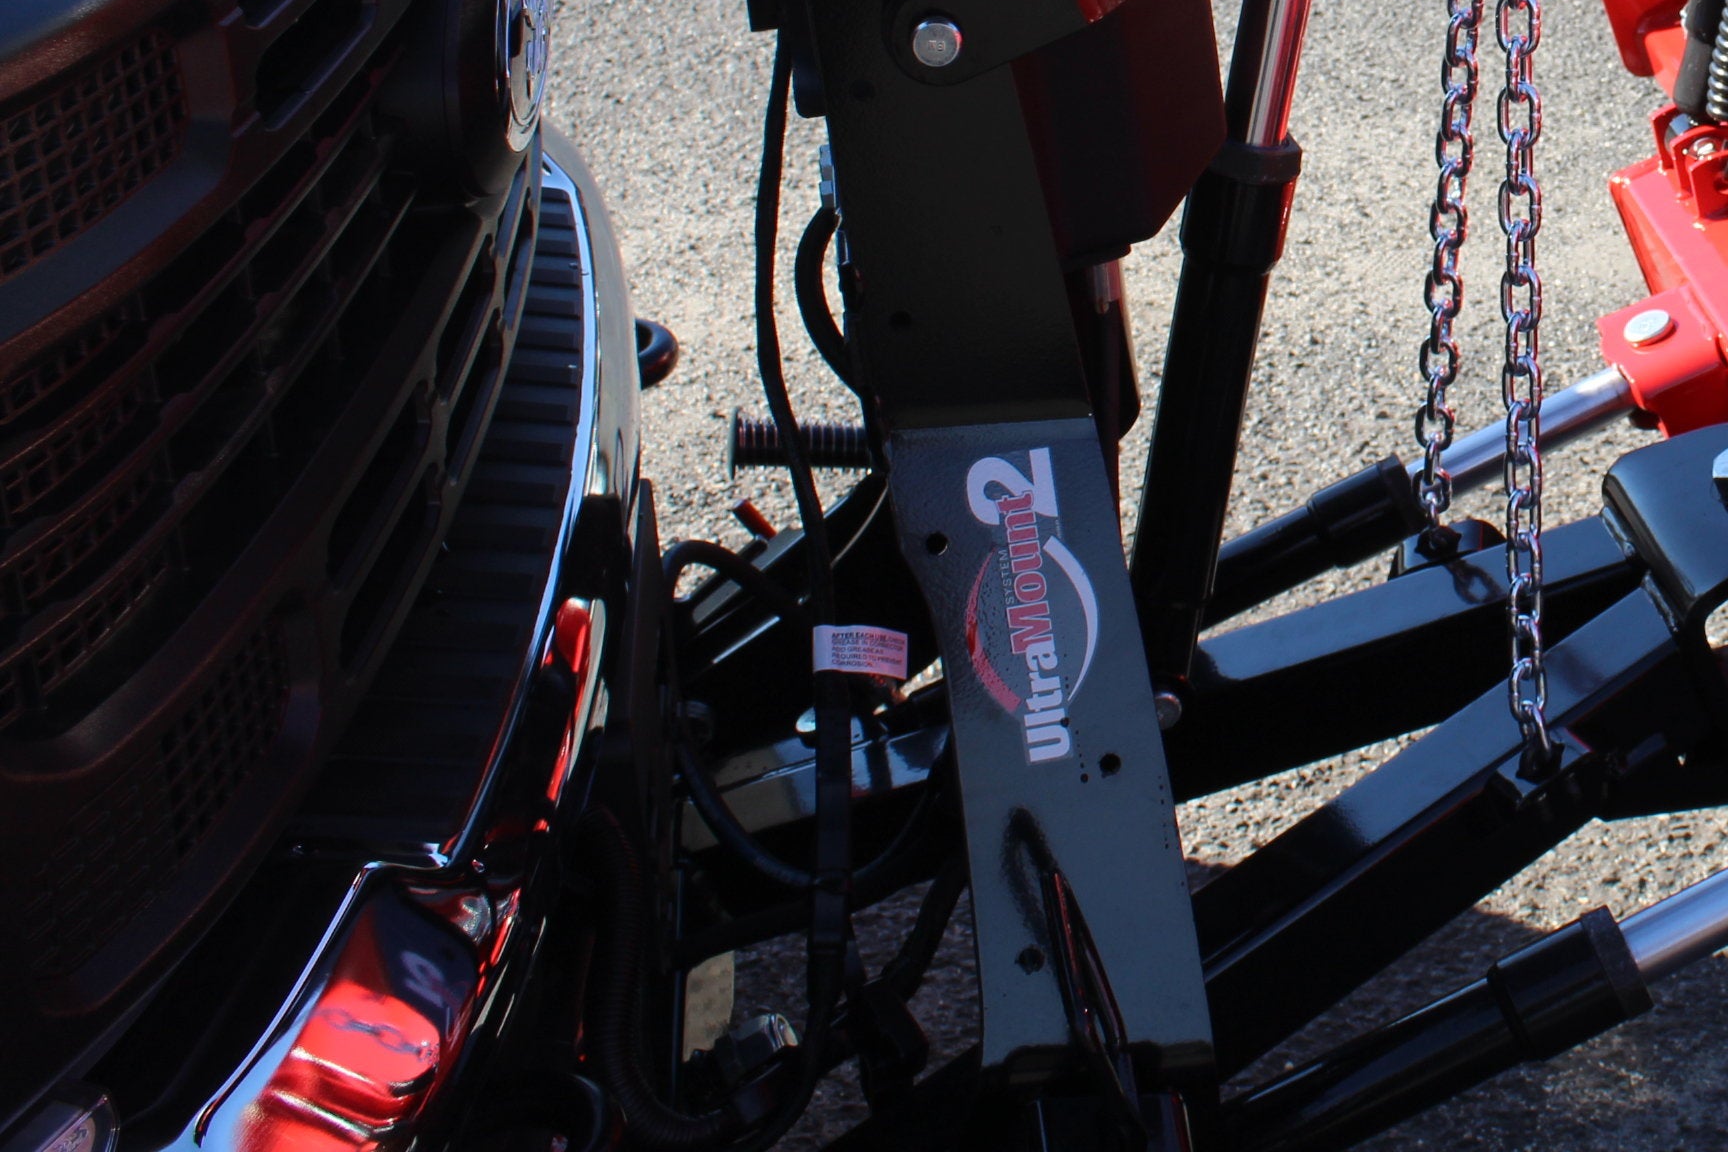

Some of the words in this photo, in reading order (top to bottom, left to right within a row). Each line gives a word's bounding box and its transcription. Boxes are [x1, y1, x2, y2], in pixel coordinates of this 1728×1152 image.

[967, 447, 1059, 526] 2
[998, 549, 1015, 605] SYSTEM
[831, 631, 855, 639] AFTER
